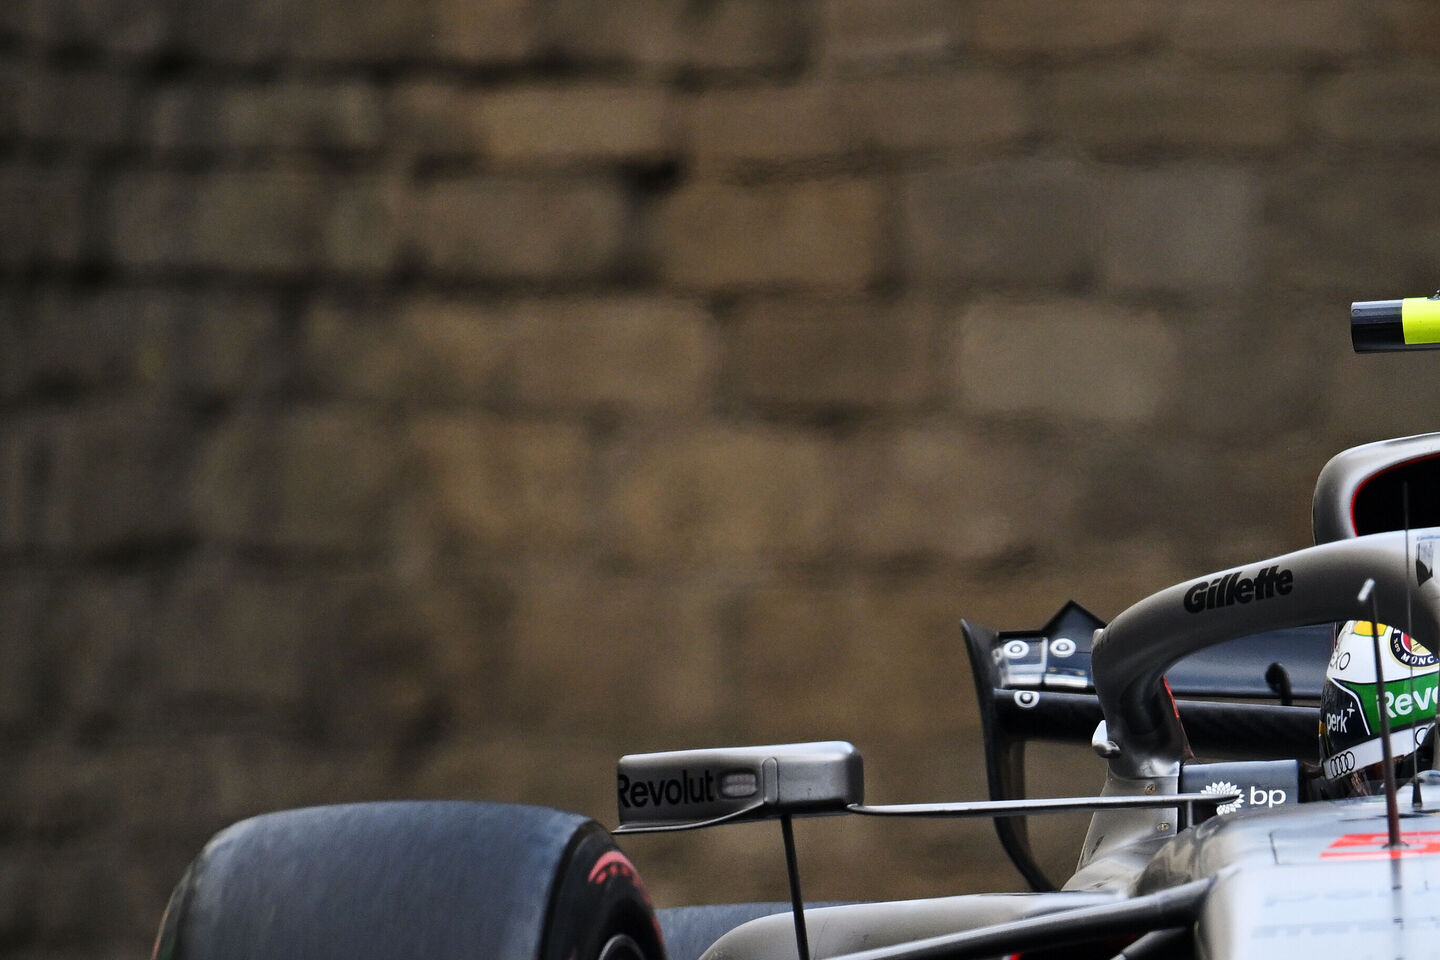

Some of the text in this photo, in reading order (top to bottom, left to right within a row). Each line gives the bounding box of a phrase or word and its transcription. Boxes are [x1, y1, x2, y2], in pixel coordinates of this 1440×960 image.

[1184, 565, 1294, 614] Gillette
[1326, 710, 1348, 735] perk
[618, 769, 715, 809] Revolut
[1250, 785, 1287, 807] bp
